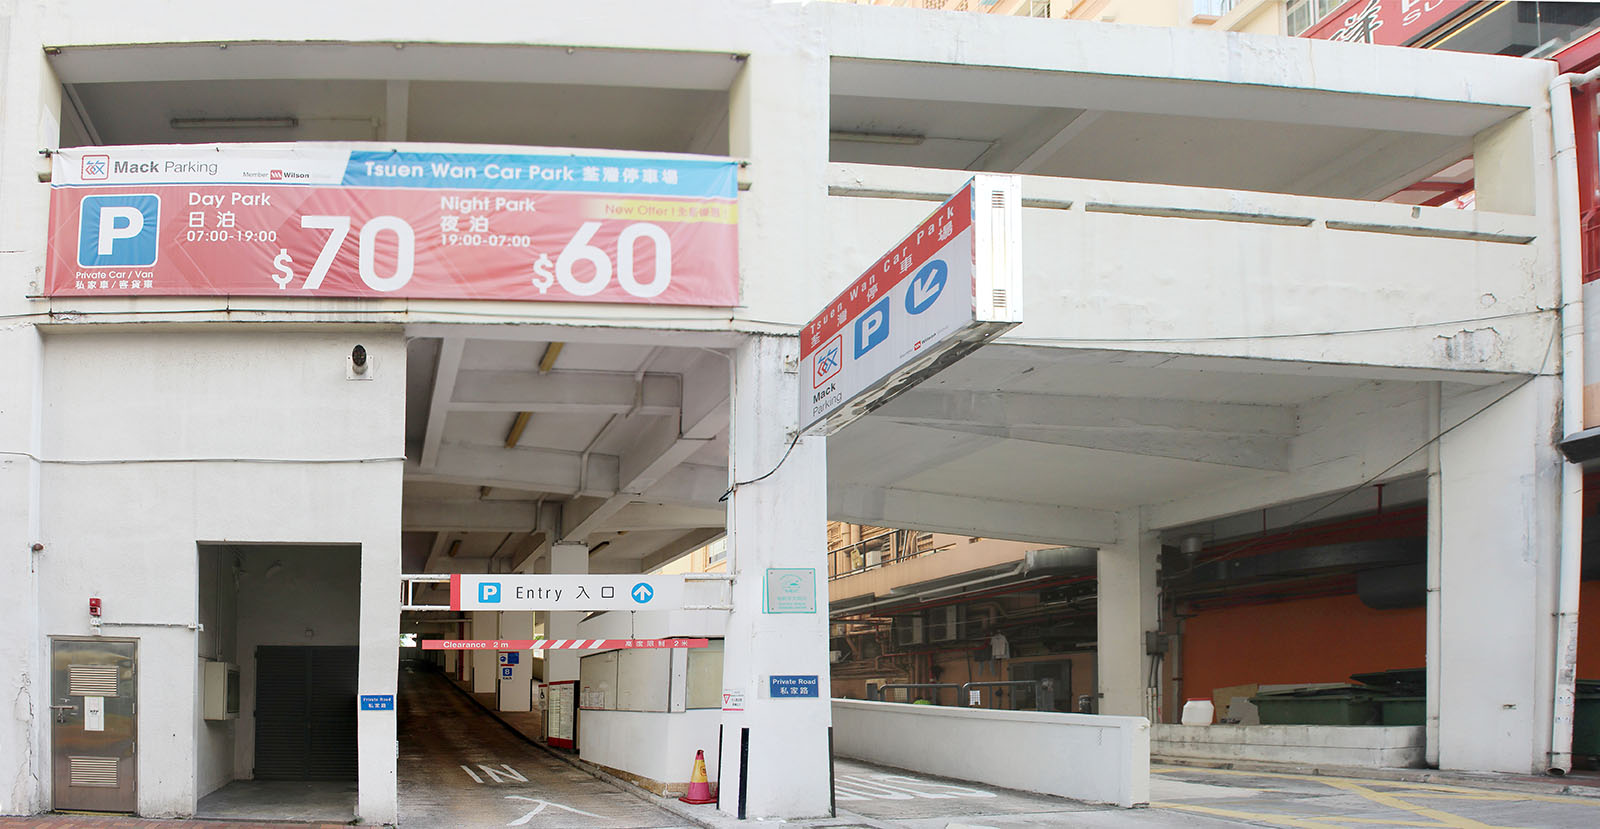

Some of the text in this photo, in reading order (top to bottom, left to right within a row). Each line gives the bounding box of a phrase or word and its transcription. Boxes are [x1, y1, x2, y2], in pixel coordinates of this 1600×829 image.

[113, 160, 218, 176] Mack Parking
[283, 171, 310, 179] Wilson
[365, 162, 574, 182] Tsuen Wan Car Park
[189, 192, 271, 207] Day Park
[441, 196, 536, 212] Night Park
[605, 204, 634, 215] New
[97, 206, 144, 256] P
[186, 230, 277, 243] 07:00-19:00
[441, 234, 531, 248] 19:00-07:00
[271, 215, 415, 292] $70
[532, 221, 672, 298] $60
[75, 271, 107, 279] Private
[108, 270, 126, 279] Car
[134, 270, 154, 279] Van
[810, 205, 954, 335] Tsuen Wan Car Park
[862, 311, 883, 350] P
[812, 382, 837, 404] Mack
[812, 391, 843, 417] Parking
[483, 585, 498, 601] P
[516, 586, 563, 602] Entry
[576, 586, 615, 599] 入口
[460, 764, 530, 784] IN
